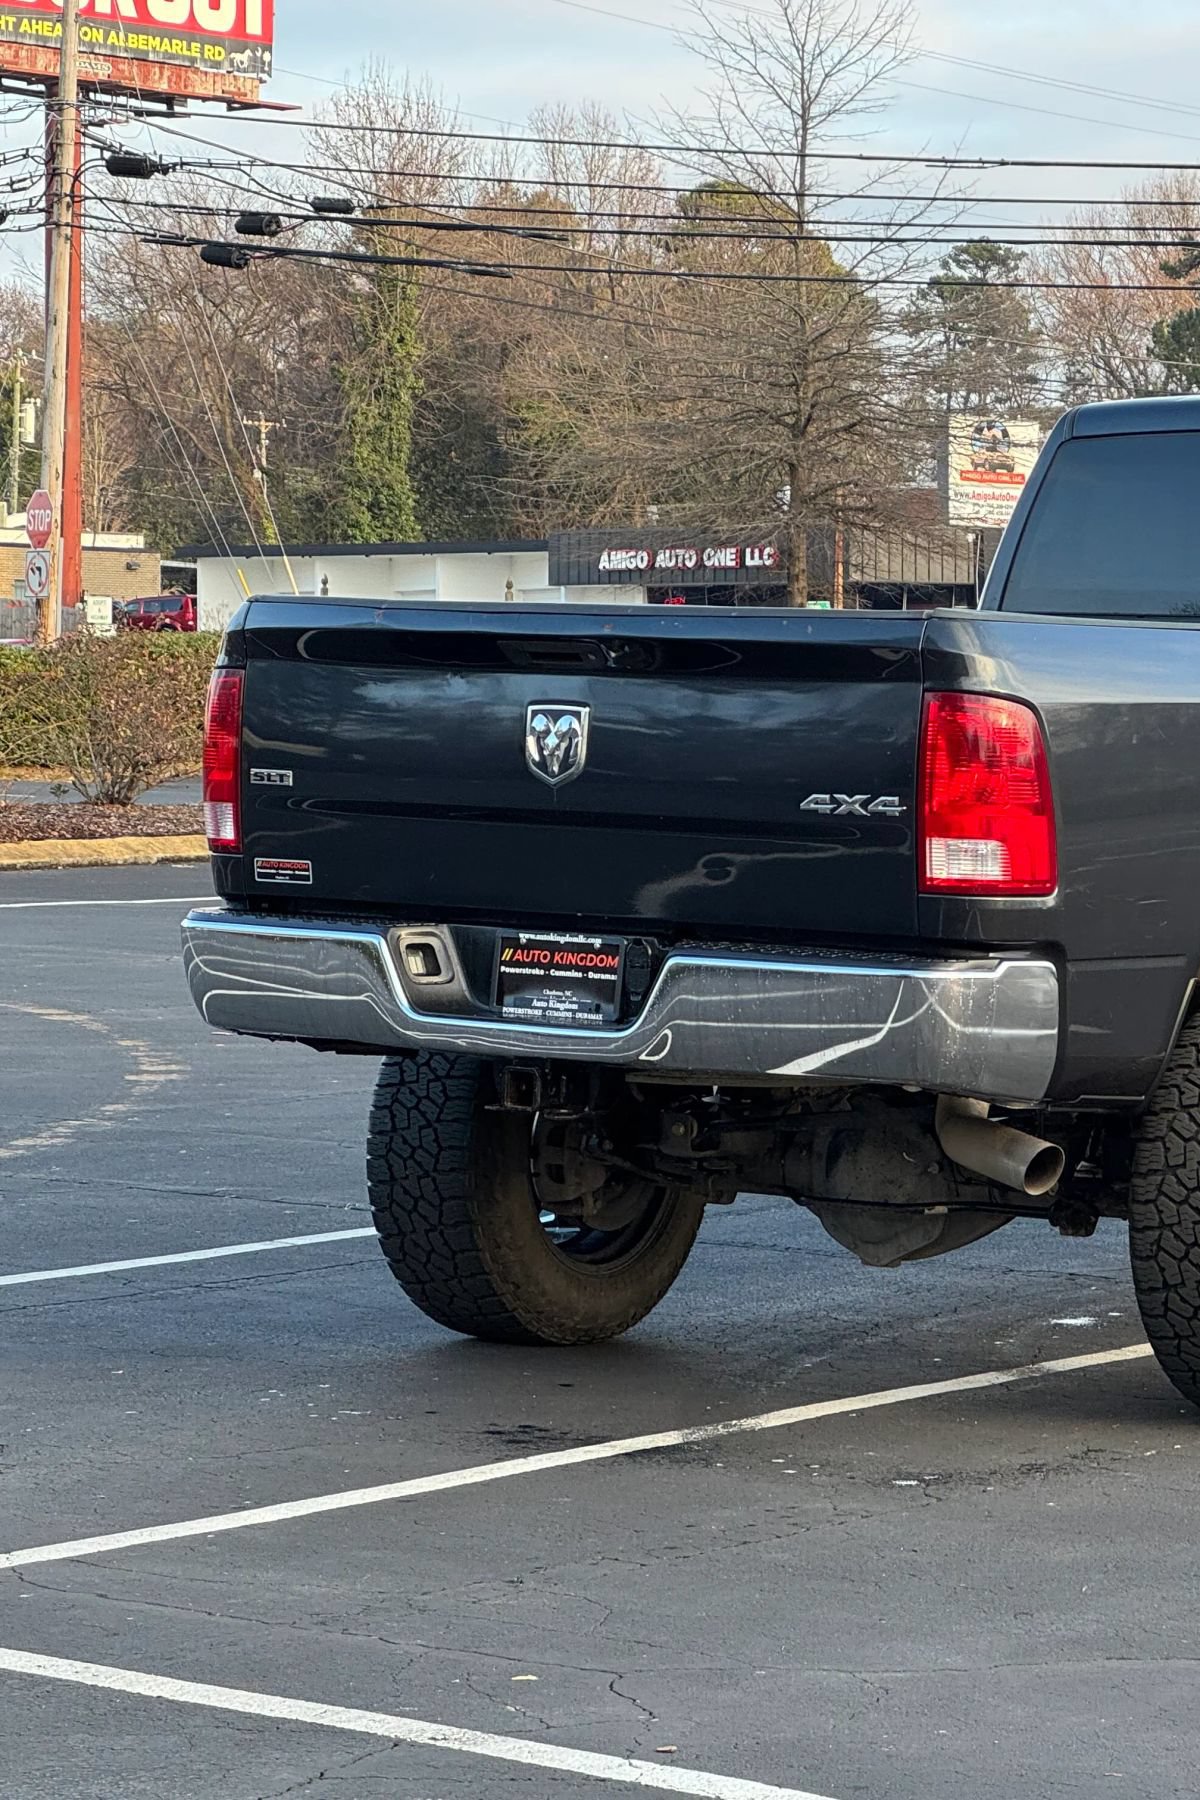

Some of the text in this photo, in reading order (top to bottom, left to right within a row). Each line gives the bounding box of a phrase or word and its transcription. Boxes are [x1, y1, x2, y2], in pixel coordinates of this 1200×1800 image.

[19, 18, 63, 37] AHEA
[79, 26, 104, 43] ON
[107, 31, 201, 57] ALBEMARLE
[203, 44, 226, 61] RD
[27, 509, 52, 532] STOP
[598, 545, 778, 570] AMIGO AUTO ONE LLC
[251, 770, 290, 784] SLT
[279, 862, 309, 870] KINGDOM
[512, 949, 619, 968] AUTO KINGDOM
[500, 966, 545, 976] Powerstroke
[550, 969, 582, 978] Cummins
[548, 1000, 578, 1010] Kingdom
